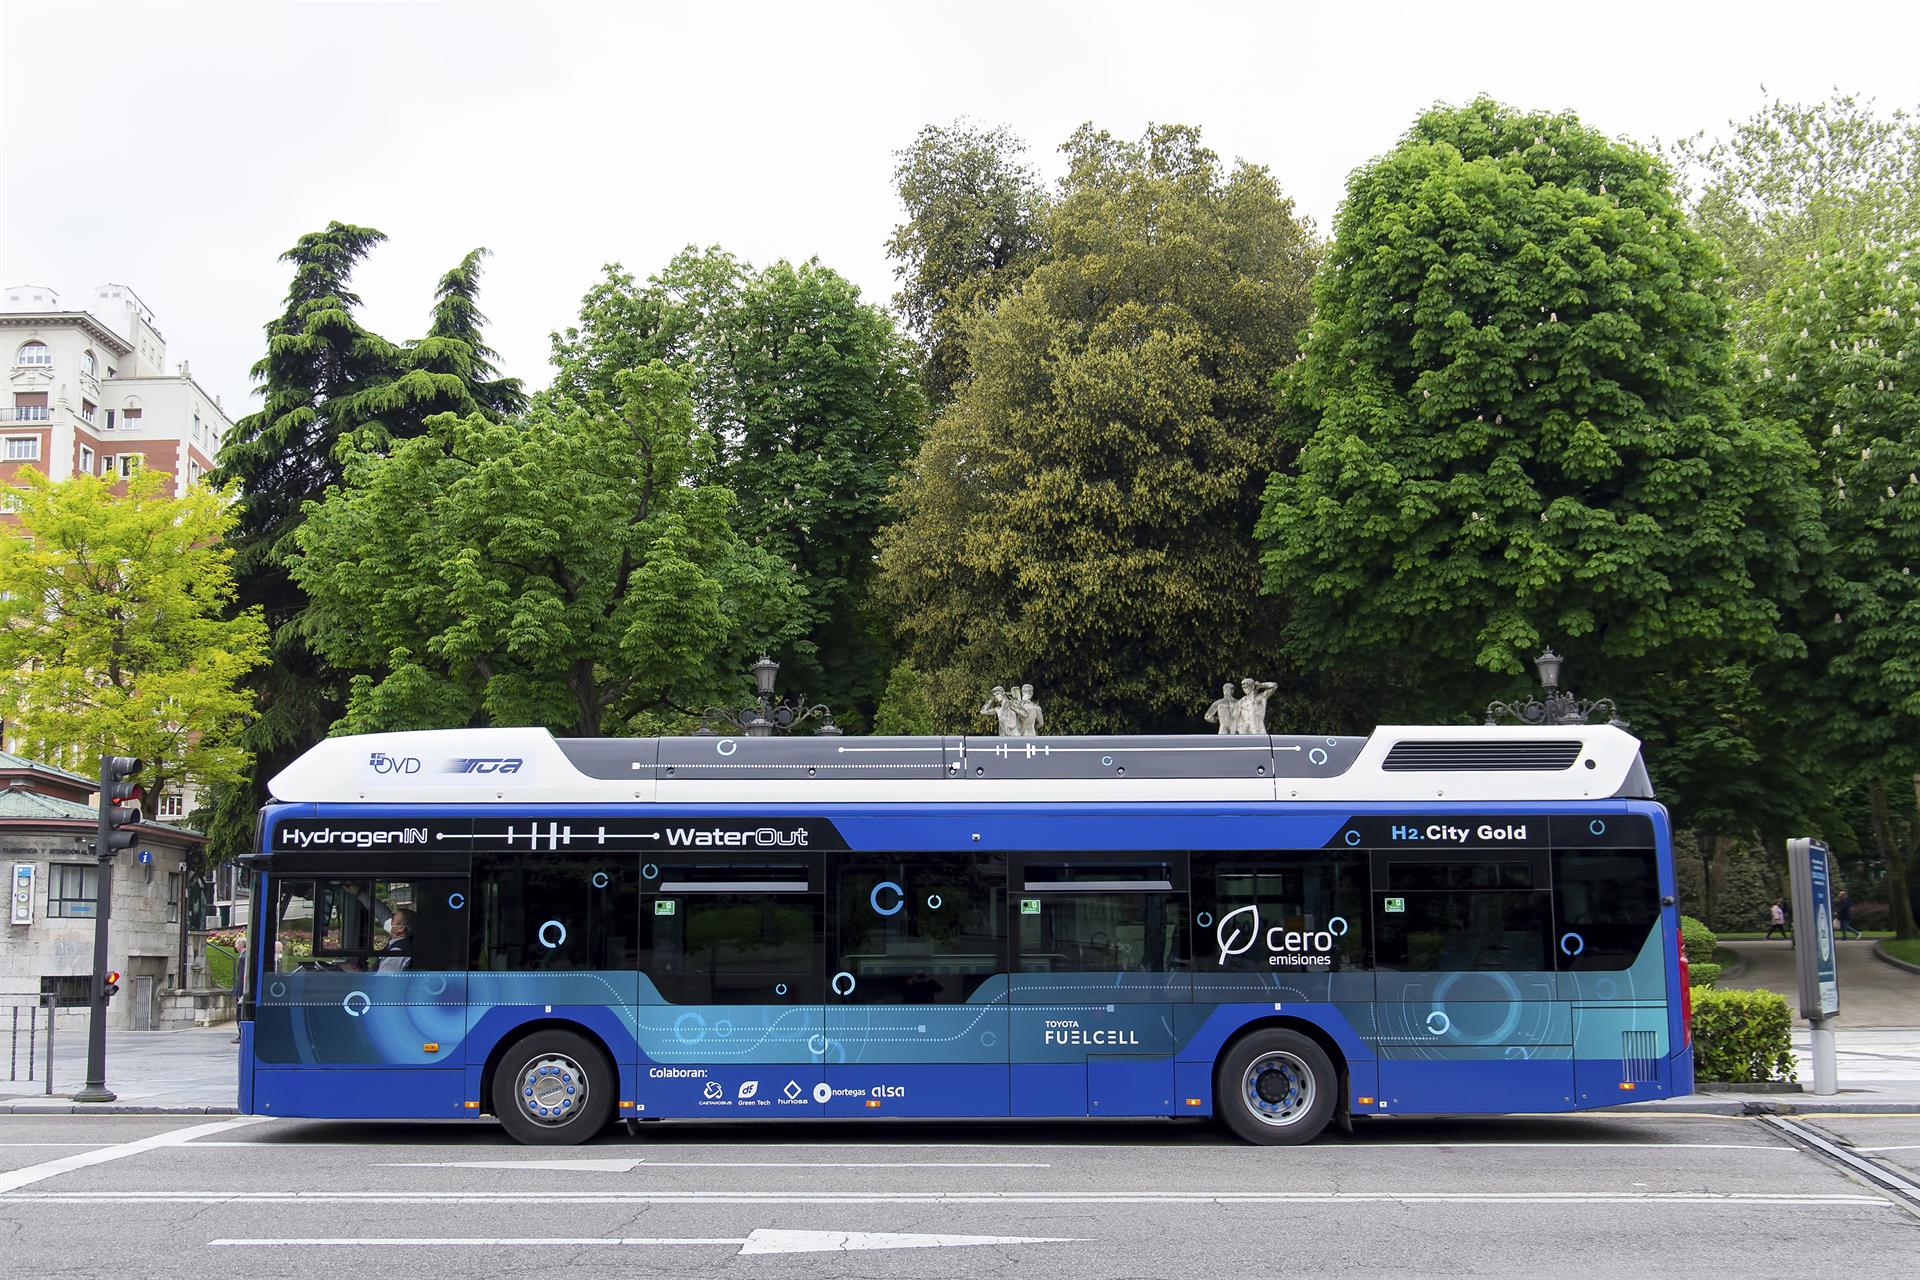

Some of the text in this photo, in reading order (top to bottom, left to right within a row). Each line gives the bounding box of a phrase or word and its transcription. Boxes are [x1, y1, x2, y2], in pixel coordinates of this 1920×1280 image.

[282, 828, 428, 848] HydrogenIN
[666, 828, 808, 846] WaterOut
[1477, 825, 1527, 840] Gold
[1266, 926, 1333, 952] Cero
[1269, 954, 1332, 965] emisiones
[1045, 1020, 1080, 1028] TOYOTA
[1045, 1030, 1139, 1045] FUELCELL
[649, 1067, 708, 1078] Colaboran:
[832, 1088, 866, 1098] nortegas
[871, 1084, 905, 1098] alsa
